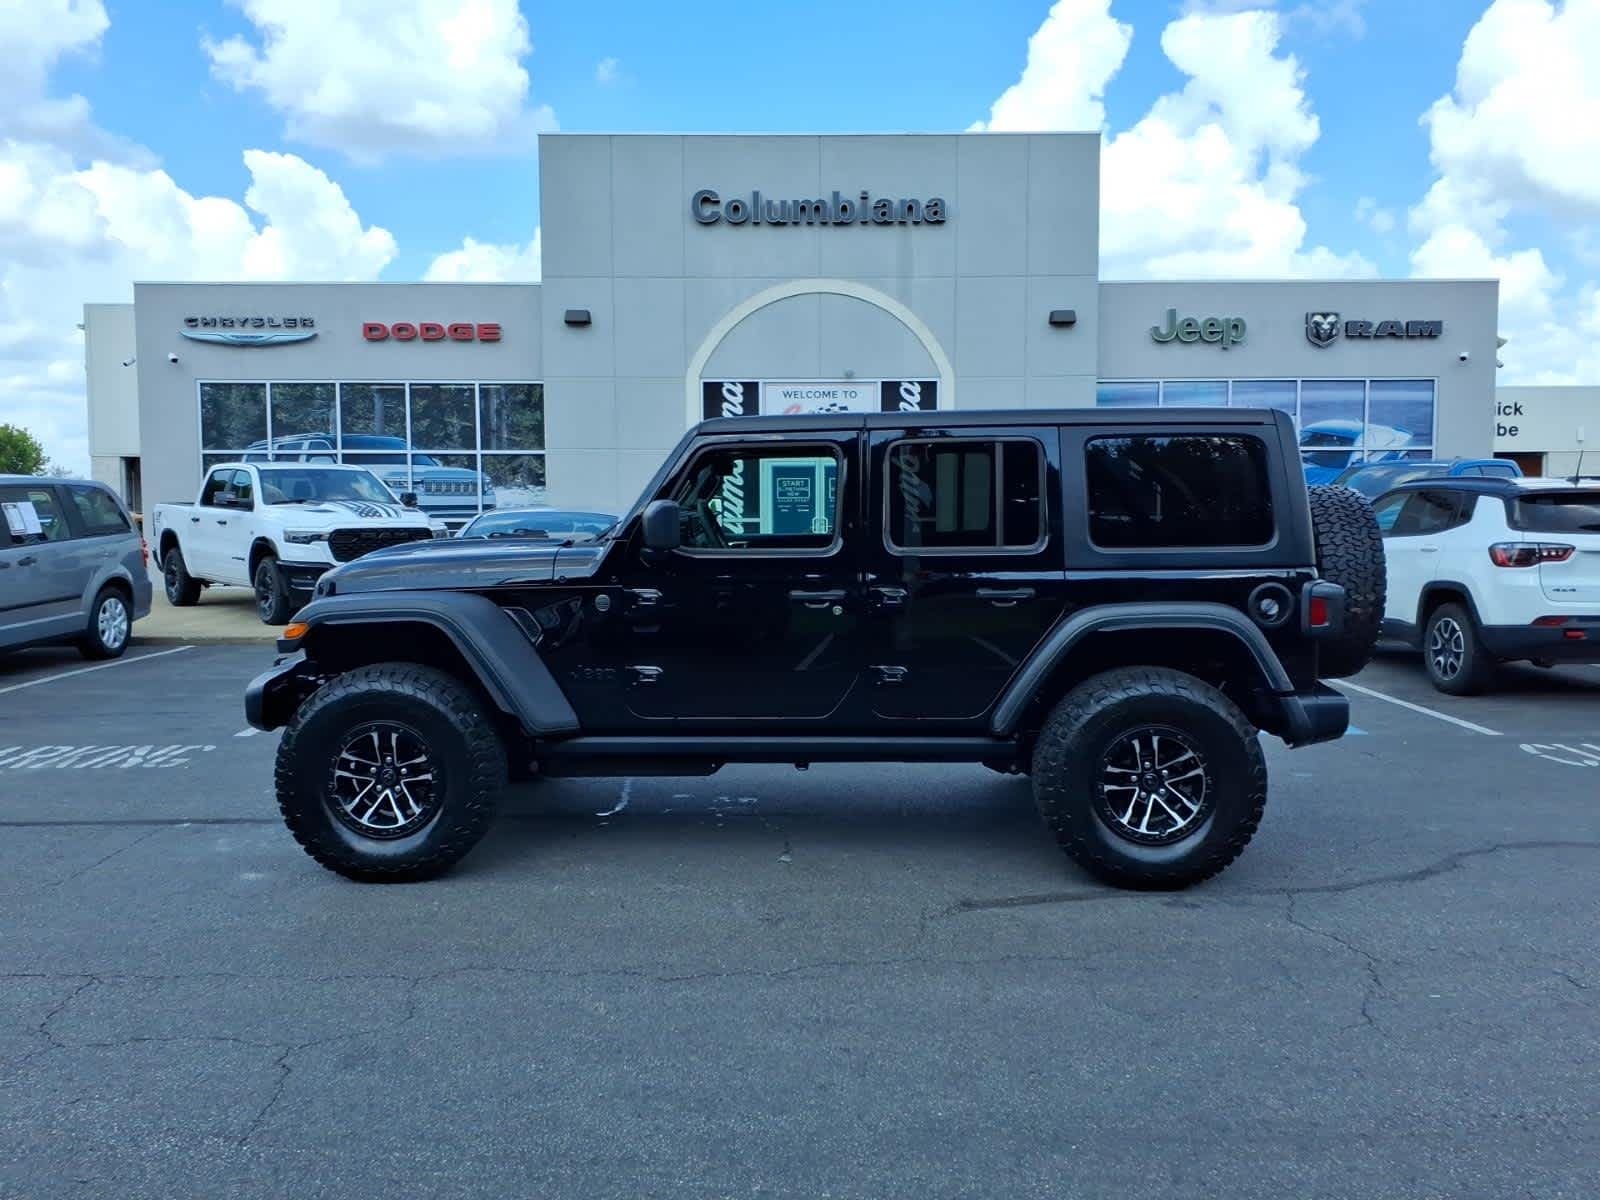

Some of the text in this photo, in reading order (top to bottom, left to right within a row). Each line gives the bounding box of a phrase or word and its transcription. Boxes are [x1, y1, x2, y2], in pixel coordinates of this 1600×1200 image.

[692, 189, 948, 226] Columbiana
[184, 316, 316, 329] CHRYSLER
[362, 322, 502, 342] DODGE
[1151, 307, 1247, 350] Jeep
[1345, 319, 1443, 339] RAM
[782, 390, 858, 399] WELCOME TO
